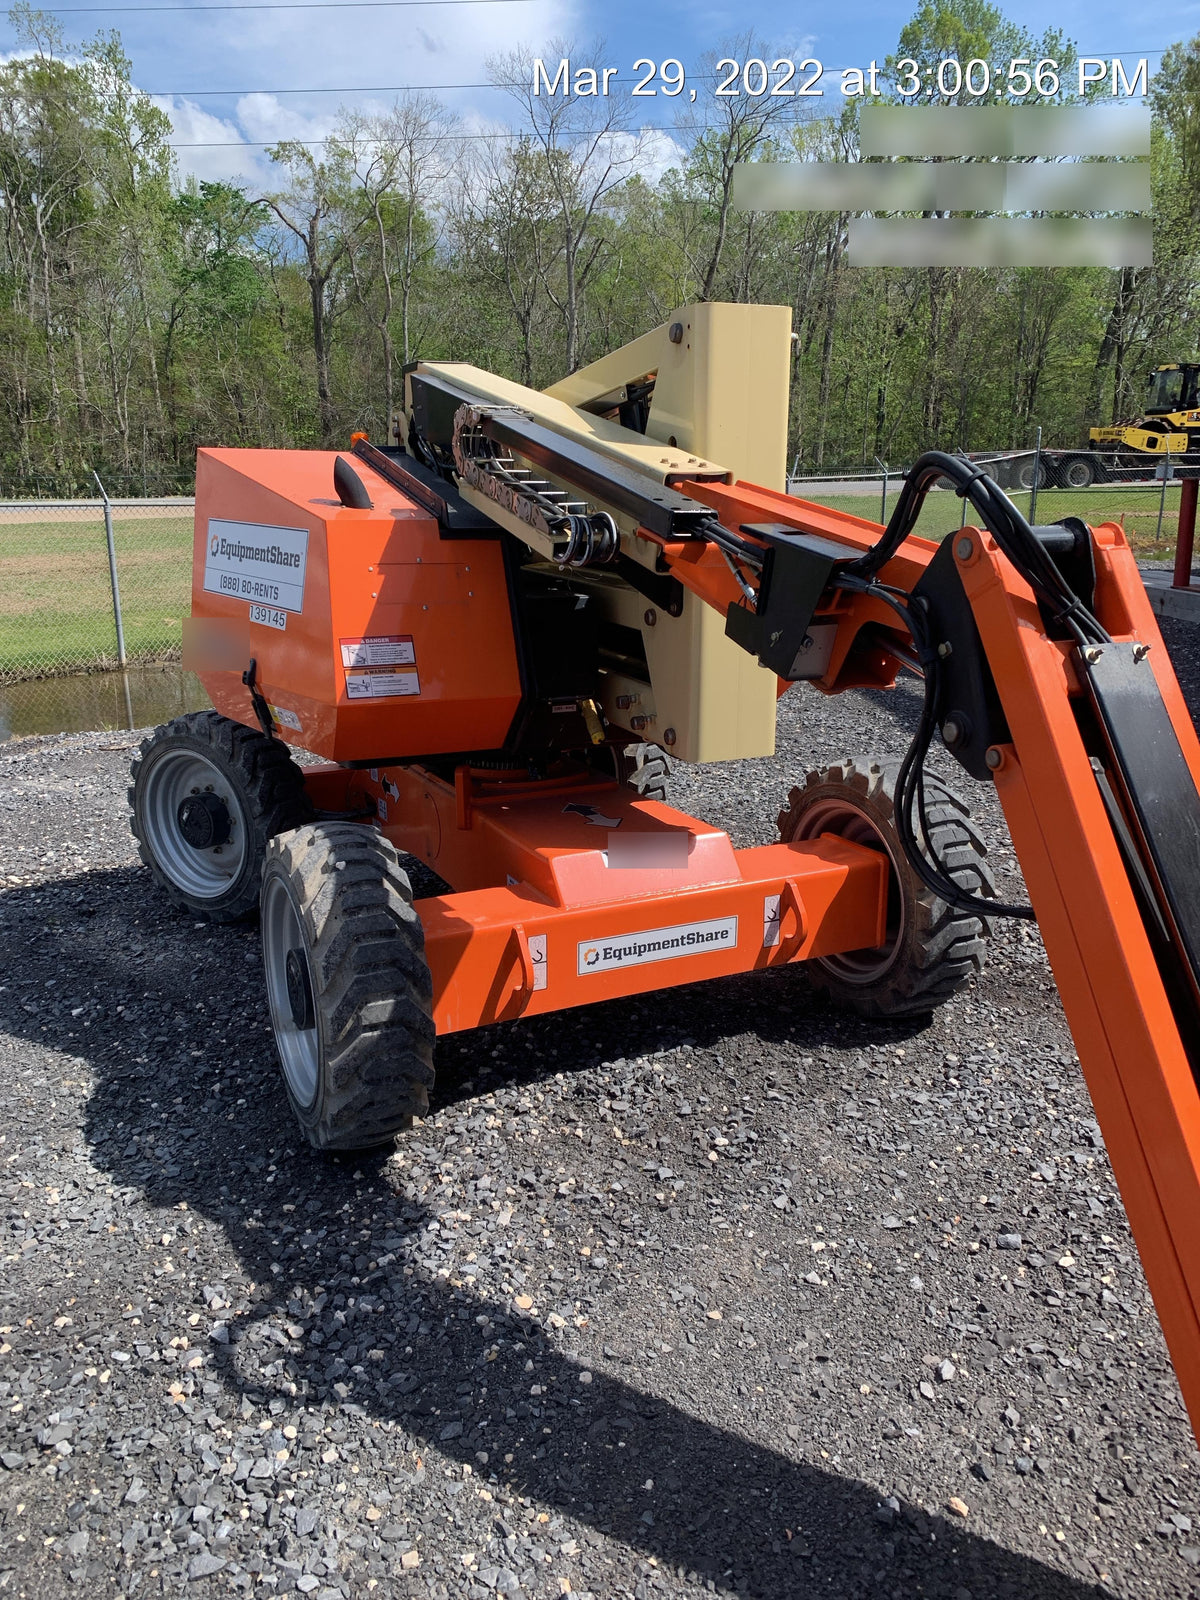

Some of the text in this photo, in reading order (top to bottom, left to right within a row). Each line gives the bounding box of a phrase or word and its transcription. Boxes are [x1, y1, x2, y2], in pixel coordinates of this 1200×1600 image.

[220, 538, 301, 568] EquipmentShare
[220, 574, 279, 600] (888) 80-RENTS
[250, 605, 285, 627] 139145
[602, 929, 729, 961] EquipmentShare
